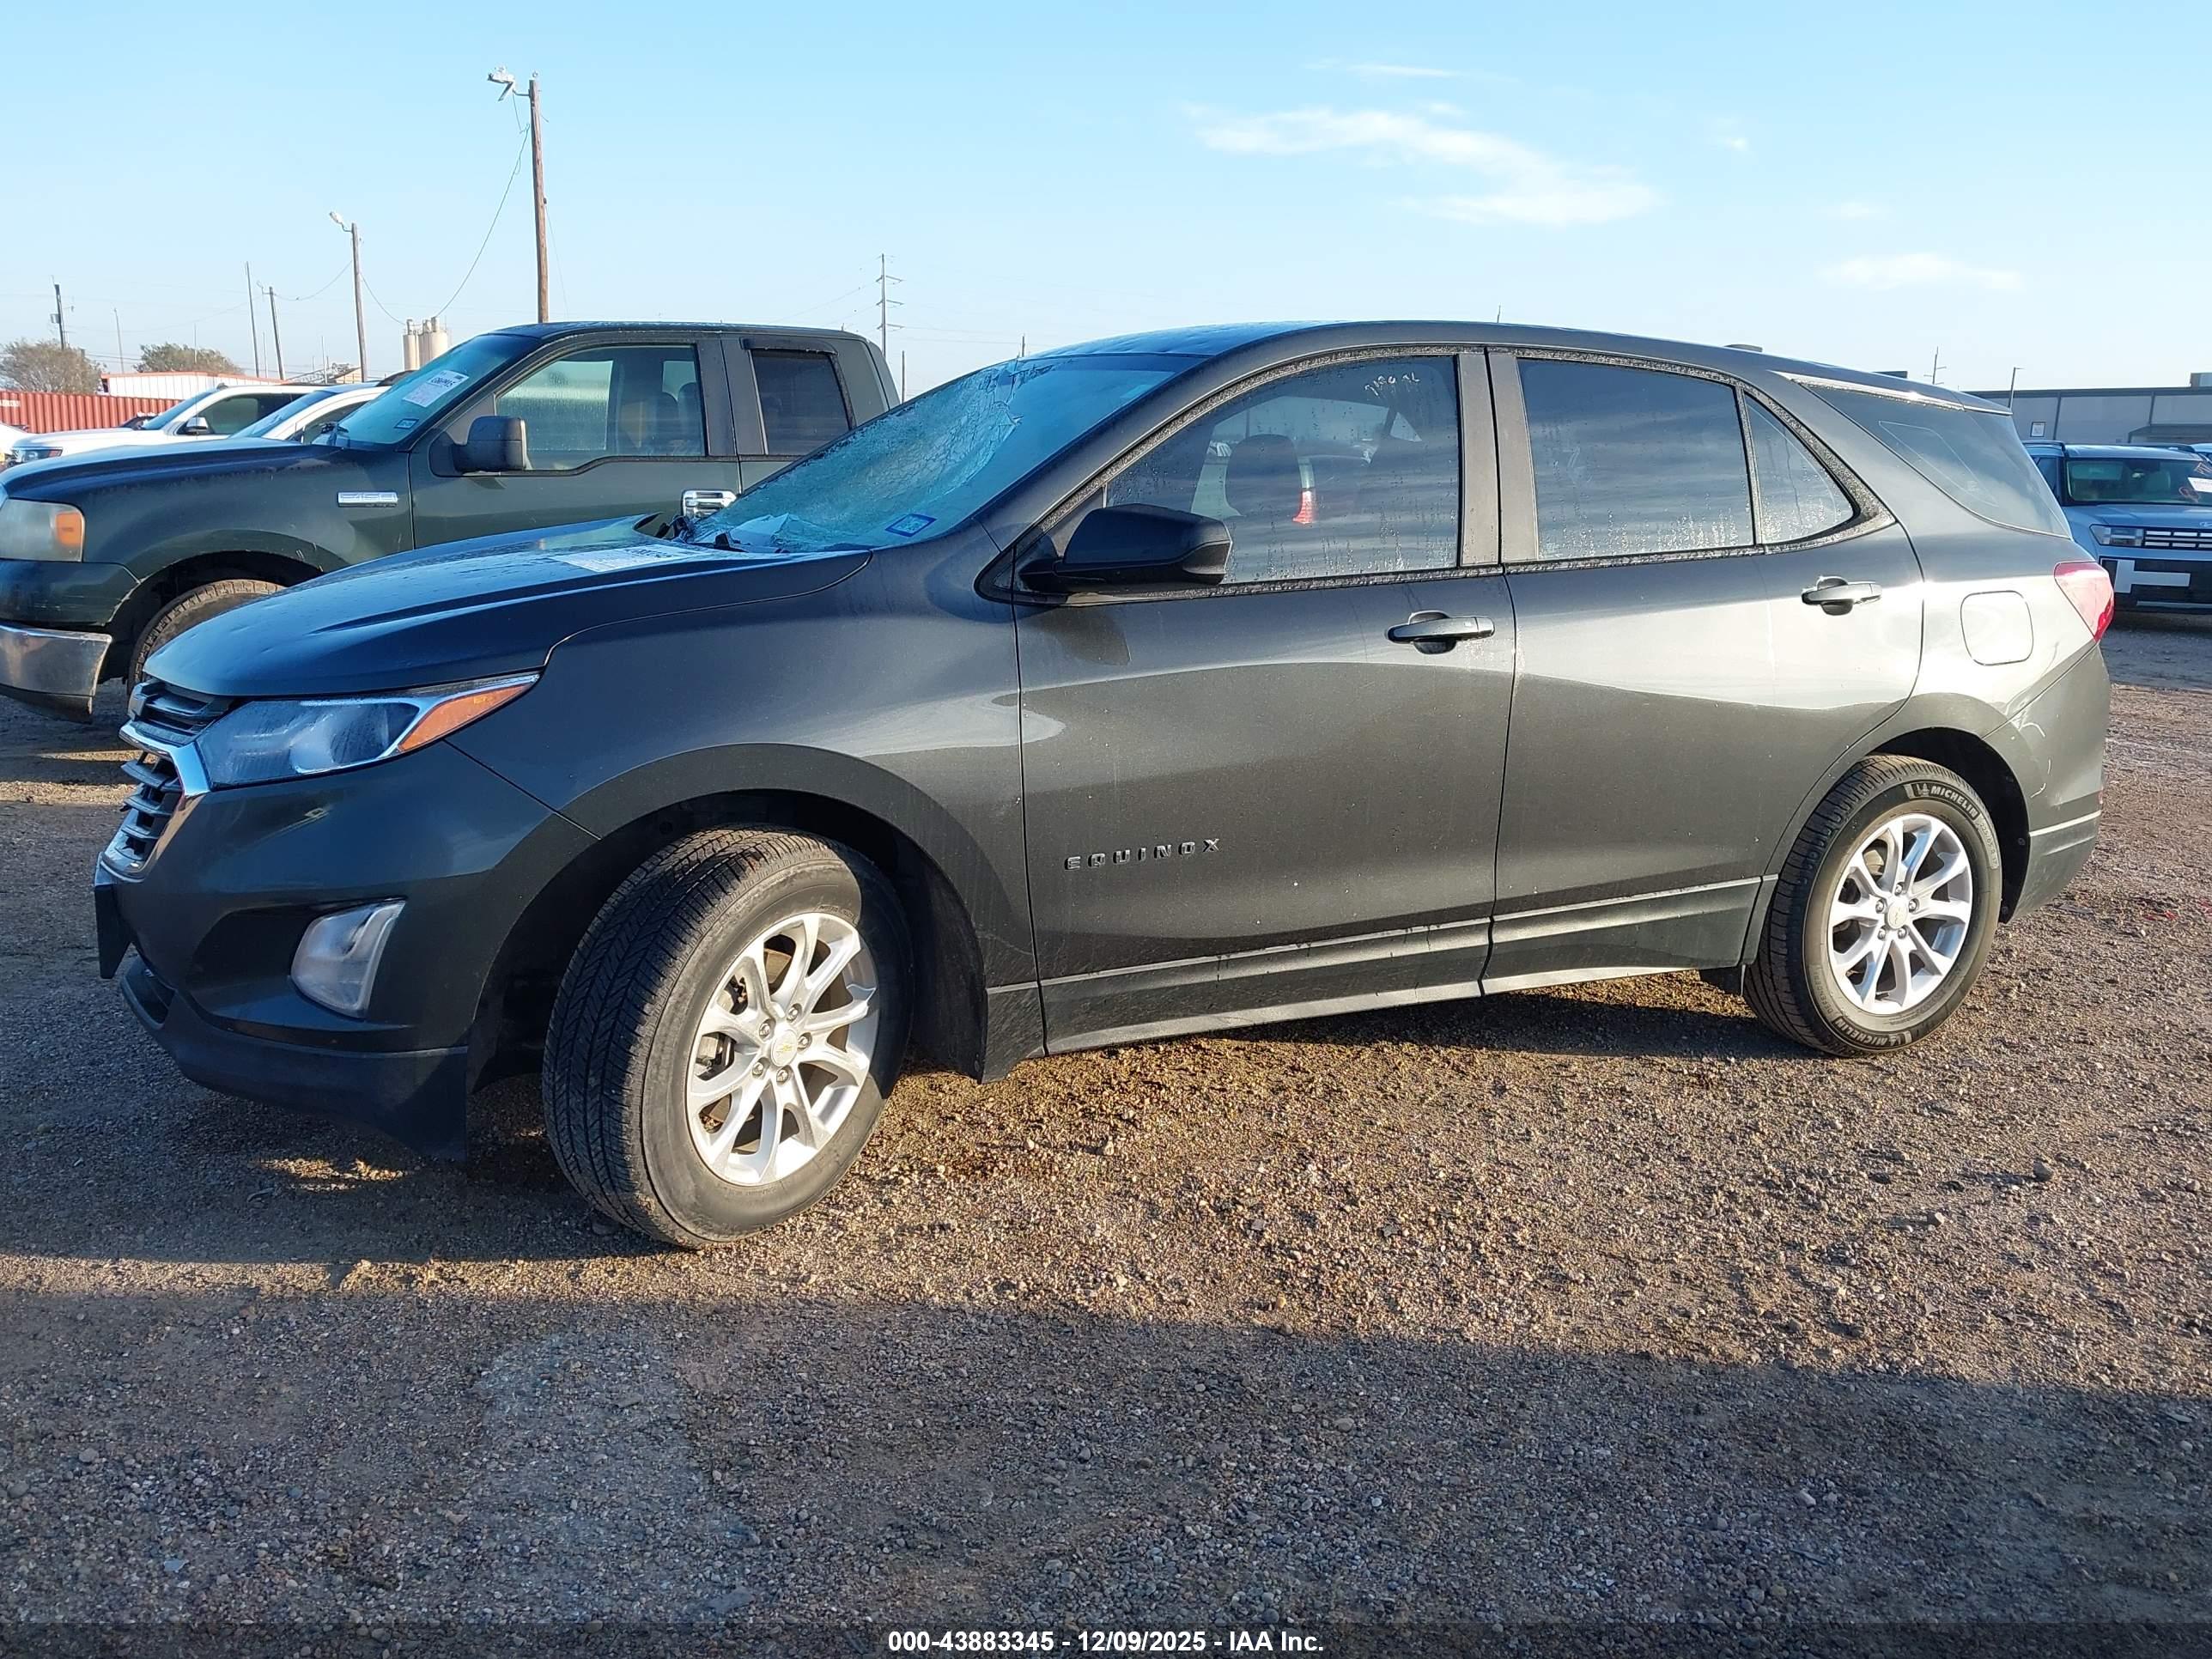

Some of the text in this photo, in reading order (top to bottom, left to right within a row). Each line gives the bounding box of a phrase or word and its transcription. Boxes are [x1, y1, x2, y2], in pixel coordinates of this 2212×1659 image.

[1930, 786, 1978, 818] MICHELIN
[1064, 838, 1220, 870] EQUINOX
[1834, 1018, 1890, 1046] MICHELIN
